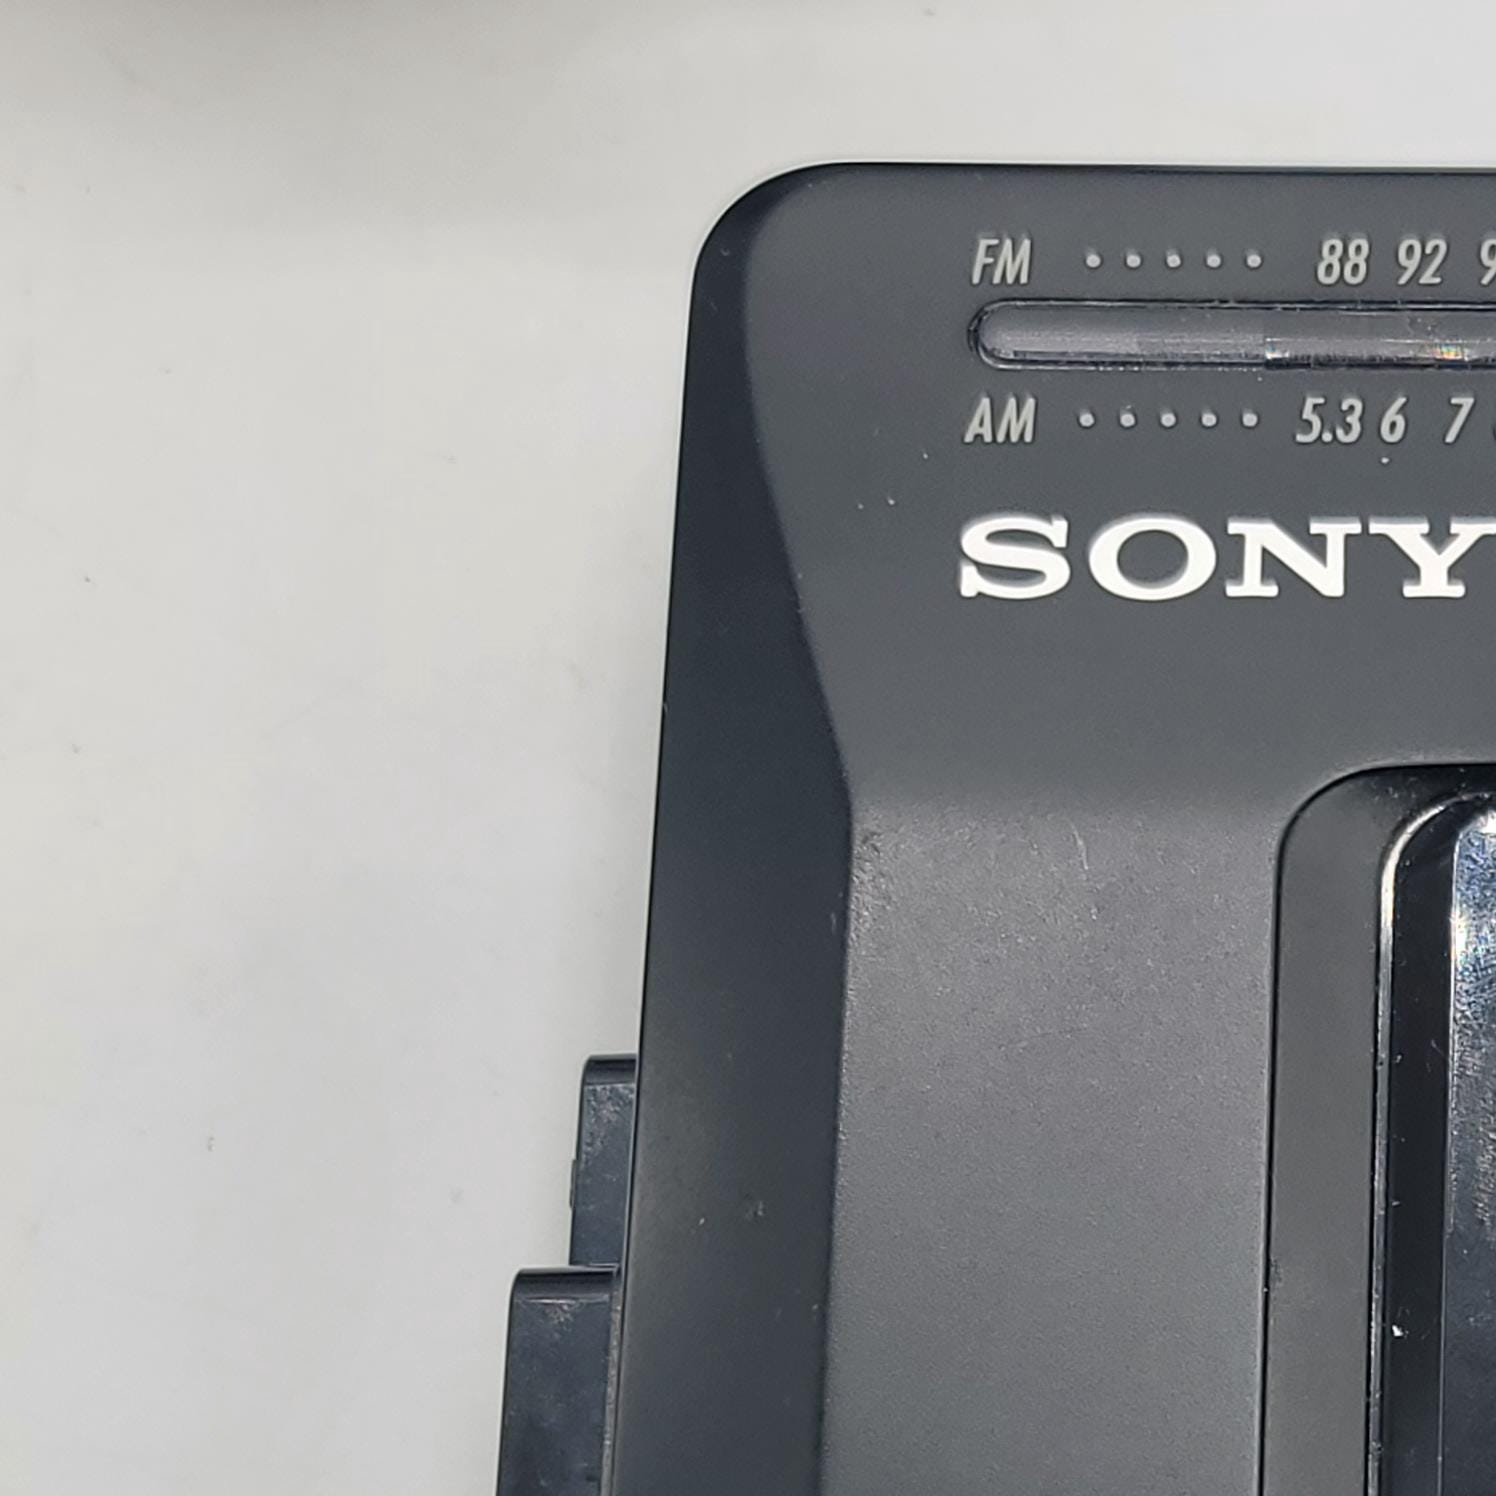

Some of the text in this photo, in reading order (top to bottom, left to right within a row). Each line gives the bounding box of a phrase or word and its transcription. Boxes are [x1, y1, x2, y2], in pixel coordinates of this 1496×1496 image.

[971, 238, 1032, 285] FM
[1316, 238, 1370, 286] 88
[1397, 238, 1448, 286] 92
[963, 397, 1037, 444] AM
[1295, 397, 1364, 444] 5.3
[1379, 397, 1408, 444] 6
[1443, 397, 1475, 444] 7
